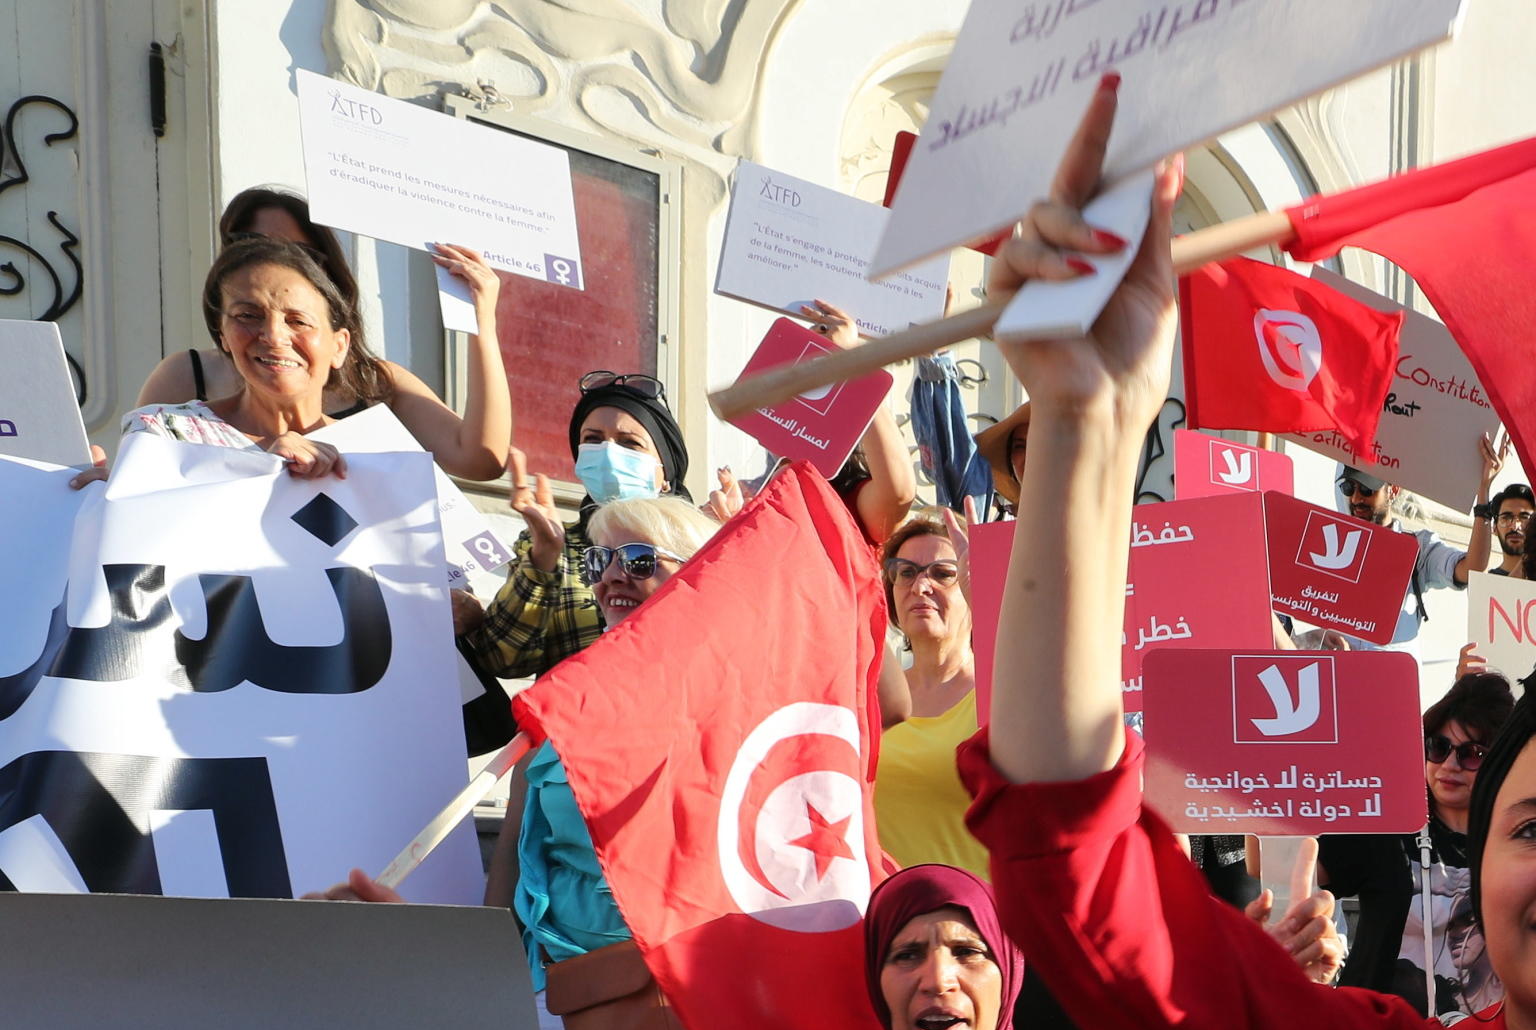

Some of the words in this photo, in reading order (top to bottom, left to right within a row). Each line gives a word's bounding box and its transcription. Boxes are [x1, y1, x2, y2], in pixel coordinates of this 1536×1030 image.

[329, 91, 383, 125] ATFD
[369, 164, 402, 179] prend
[404, 172, 421, 185] les
[423, 179, 470, 198] mesures
[473, 193, 534, 216] nécessaires
[536, 209, 556, 222] afin
[398, 186, 408, 196] la
[410, 191, 456, 209] violence
[458, 204, 492, 219] contre
[494, 213, 504, 223] la
[760, 177, 801, 208] ATFD
[483, 250, 523, 268] Article
[526, 262, 541, 273] 46
[750, 238, 762, 247] de
[763, 241, 772, 250] la
[810, 256, 823, 267] les
[825, 263, 862, 280] soutient
[911, 289, 924, 299] les
[834, 251, 869, 268] protége
[914, 277, 942, 291] acquis
[855, 318, 888, 335] Article
[792, 426, 831, 450] لمسار
[1218, 448, 1252, 484] لا
[1130, 521, 1195, 547] حفظ
[1309, 523, 1362, 570] لا
[1301, 585, 1339, 603] لتفريق
[1134, 616, 1193, 650] خطر
[1320, 609, 1376, 633] التونسيين
[1250, 661, 1320, 736] لا
[1184, 770, 1269, 793] خوانجية
[1273, 765, 1298, 788] لا
[1302, 770, 1382, 792] دساترة
[1185, 799, 1292, 821] اخشيدية
[1299, 800, 1350, 821] دولة
[1358, 793, 1382, 817] لا
